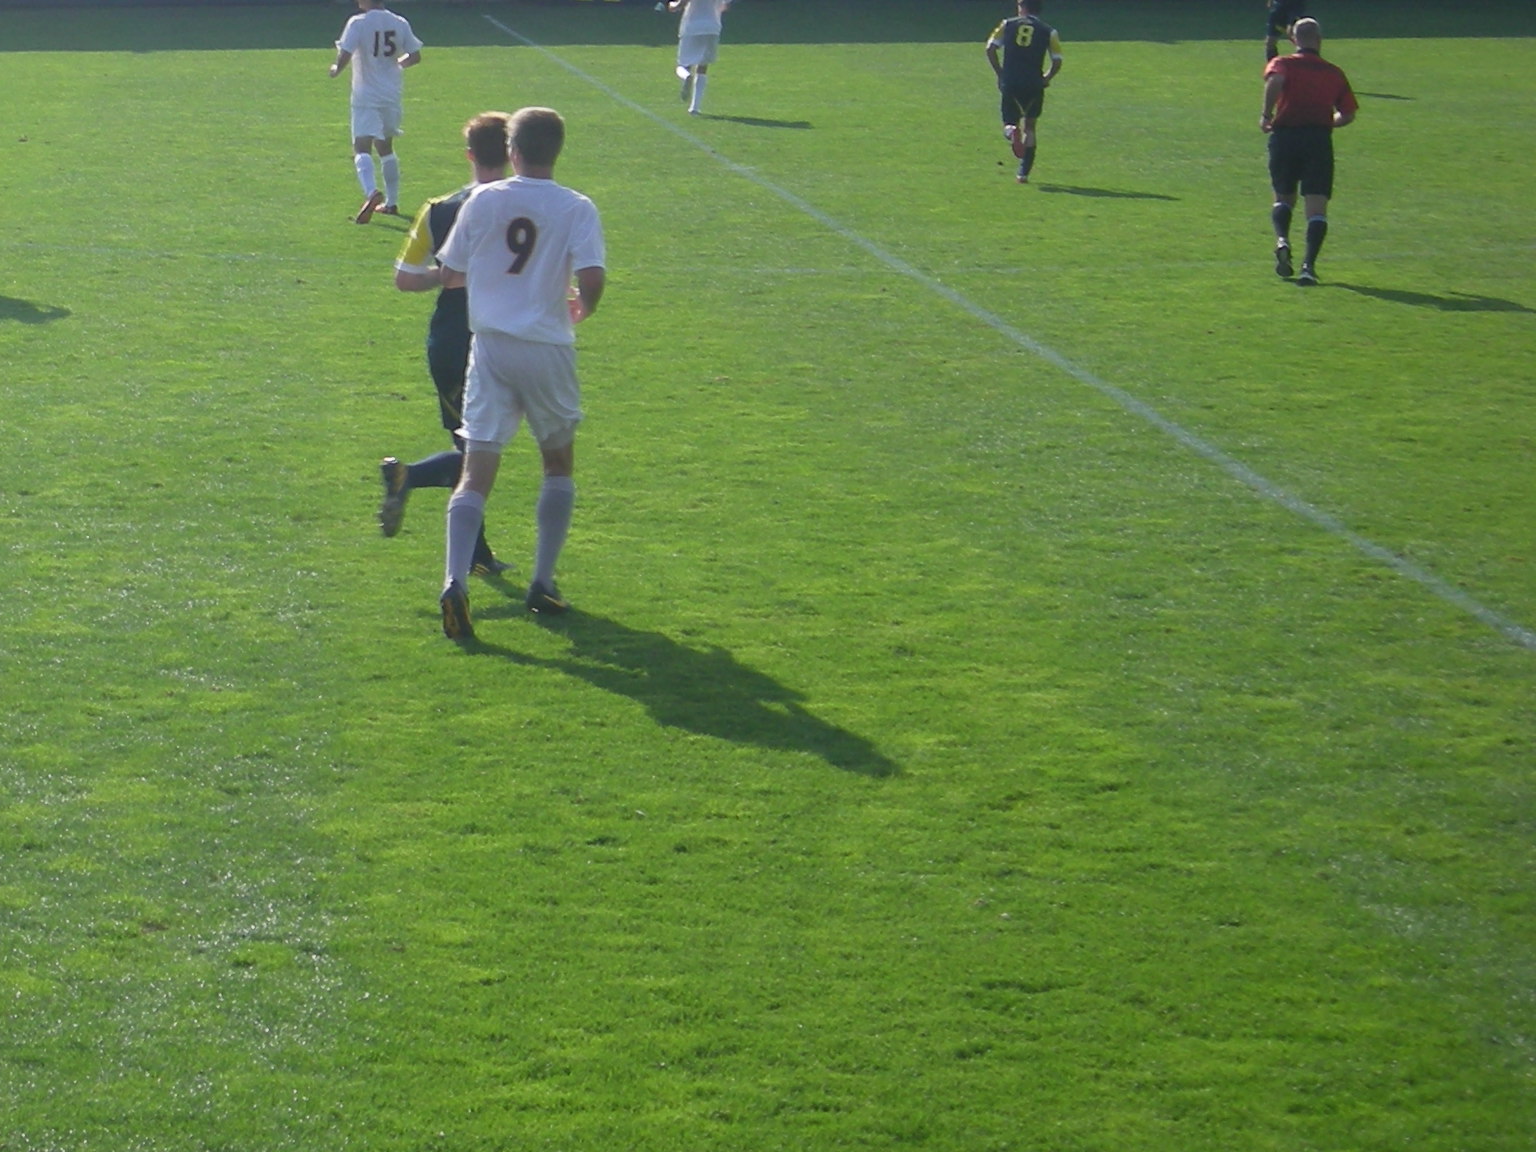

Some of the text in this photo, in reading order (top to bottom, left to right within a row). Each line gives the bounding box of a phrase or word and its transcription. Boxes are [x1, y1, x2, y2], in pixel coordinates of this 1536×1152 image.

[372, 30, 397, 58] 15
[1016, 25, 1034, 47] 8
[505, 216, 538, 275] 9
